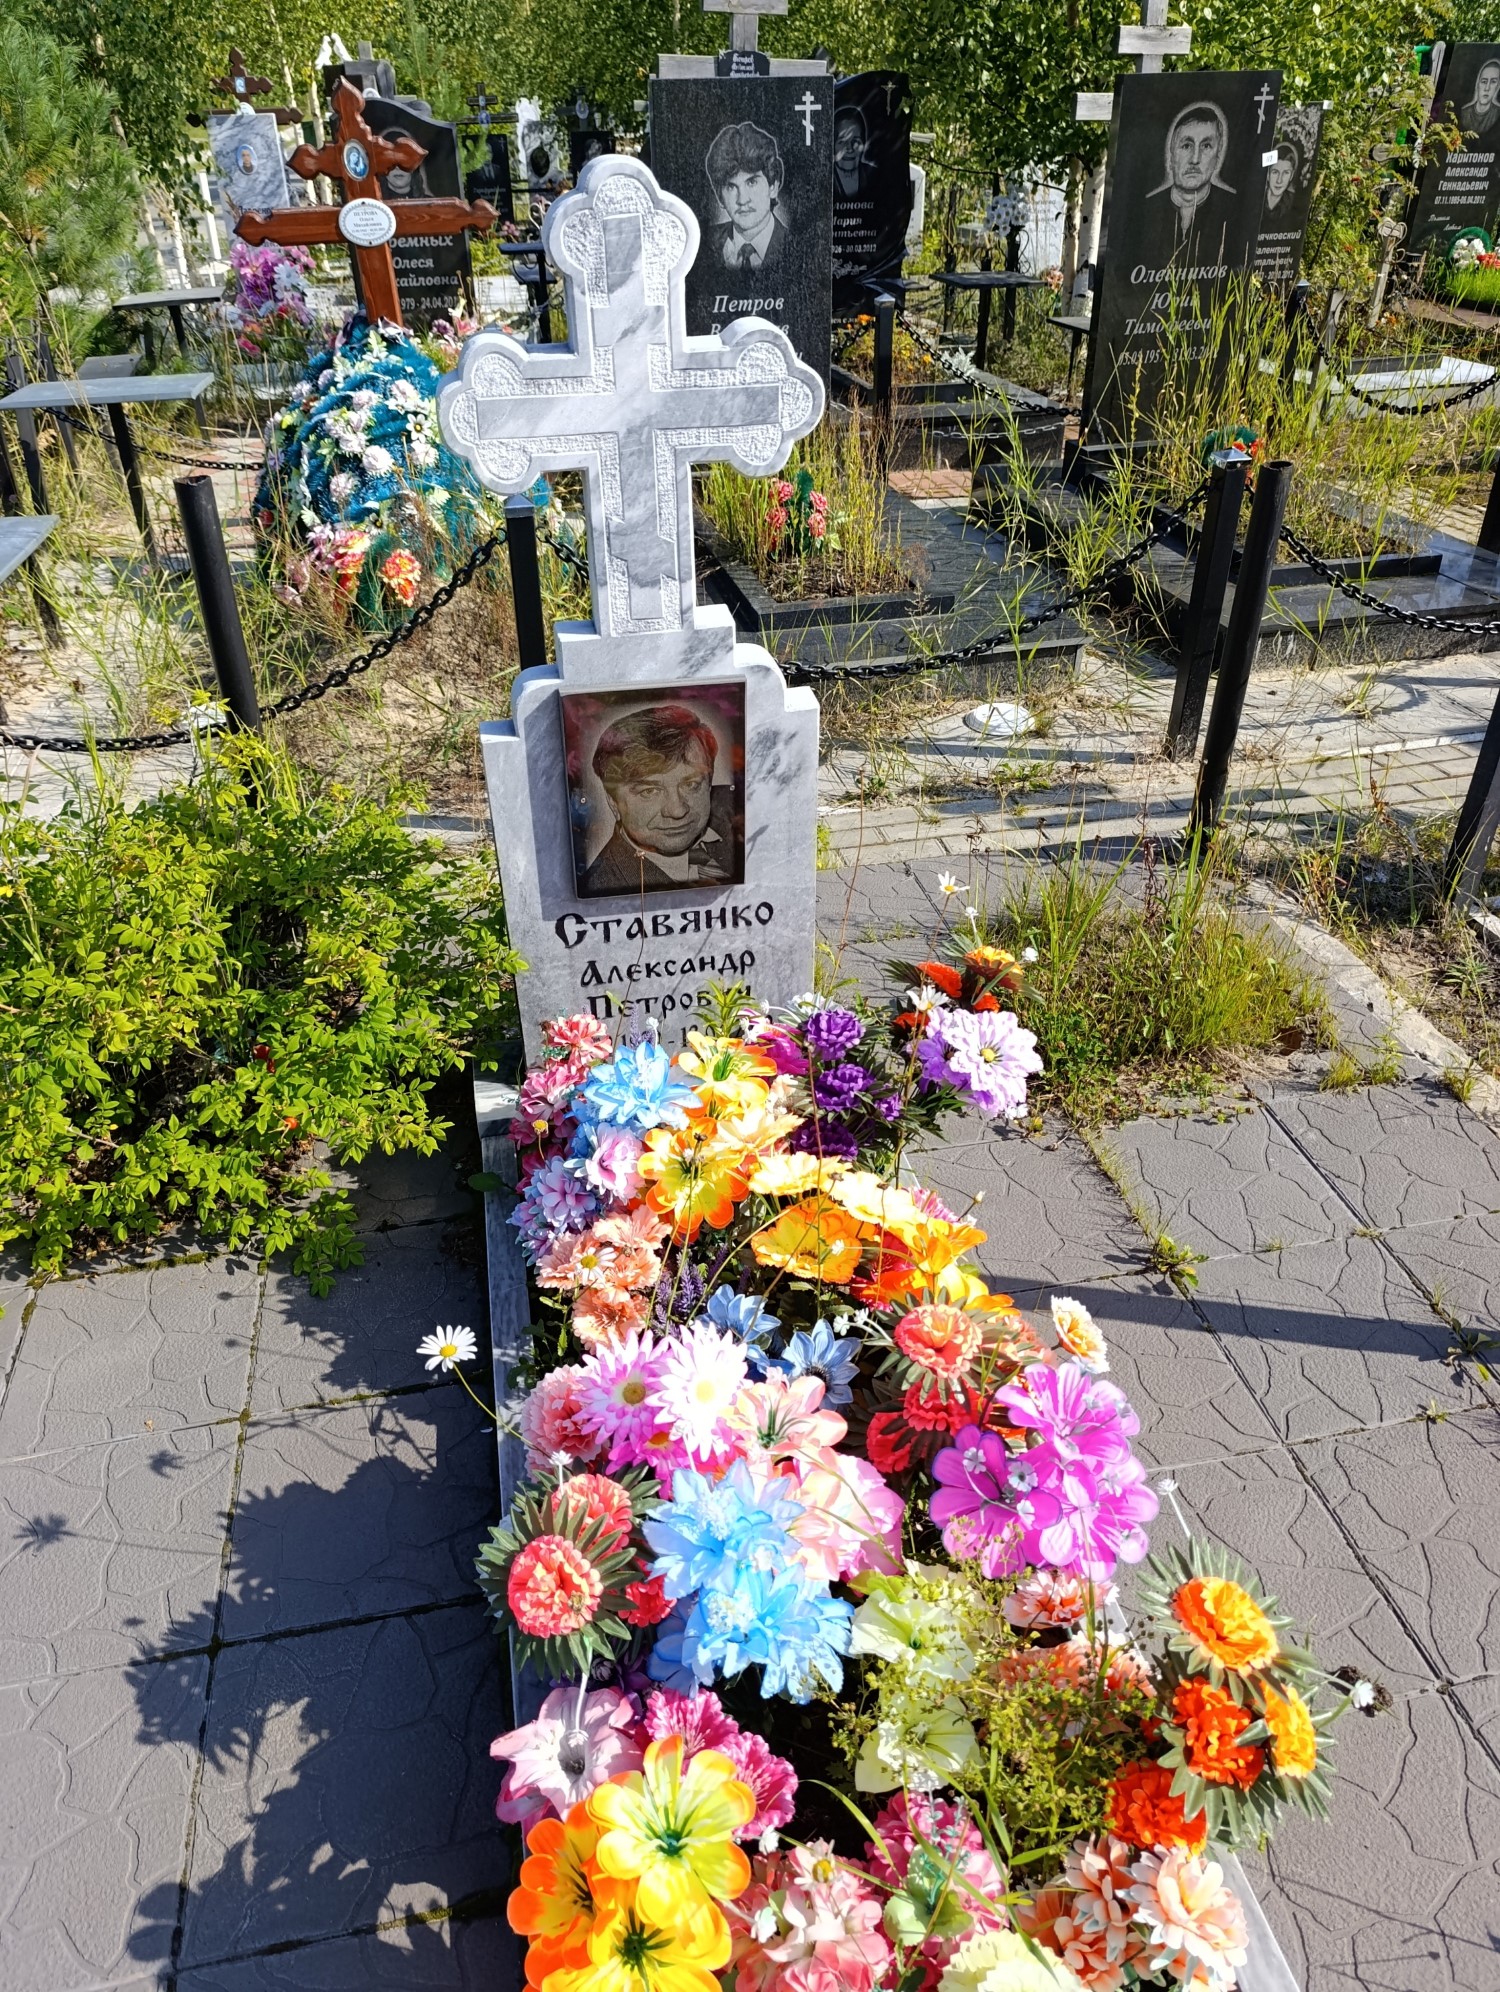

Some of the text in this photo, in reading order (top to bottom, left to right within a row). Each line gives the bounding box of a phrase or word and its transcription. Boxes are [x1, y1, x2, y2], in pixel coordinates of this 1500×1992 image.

[1445, 167, 1489, 177] Александр
[1438, 181, 1489, 191] Геннадьевич
[833, 216, 862, 228] ария
[1256, 246, 1291, 255] алентин
[392, 257, 434, 269] Олеся
[396, 273, 459, 287] айловна
[712, 295, 785, 316] Петров
[554, 901, 774, 949] Ставянко
[580, 949, 756, 988] Александр
[586, 984, 753, 1021] Петровч
